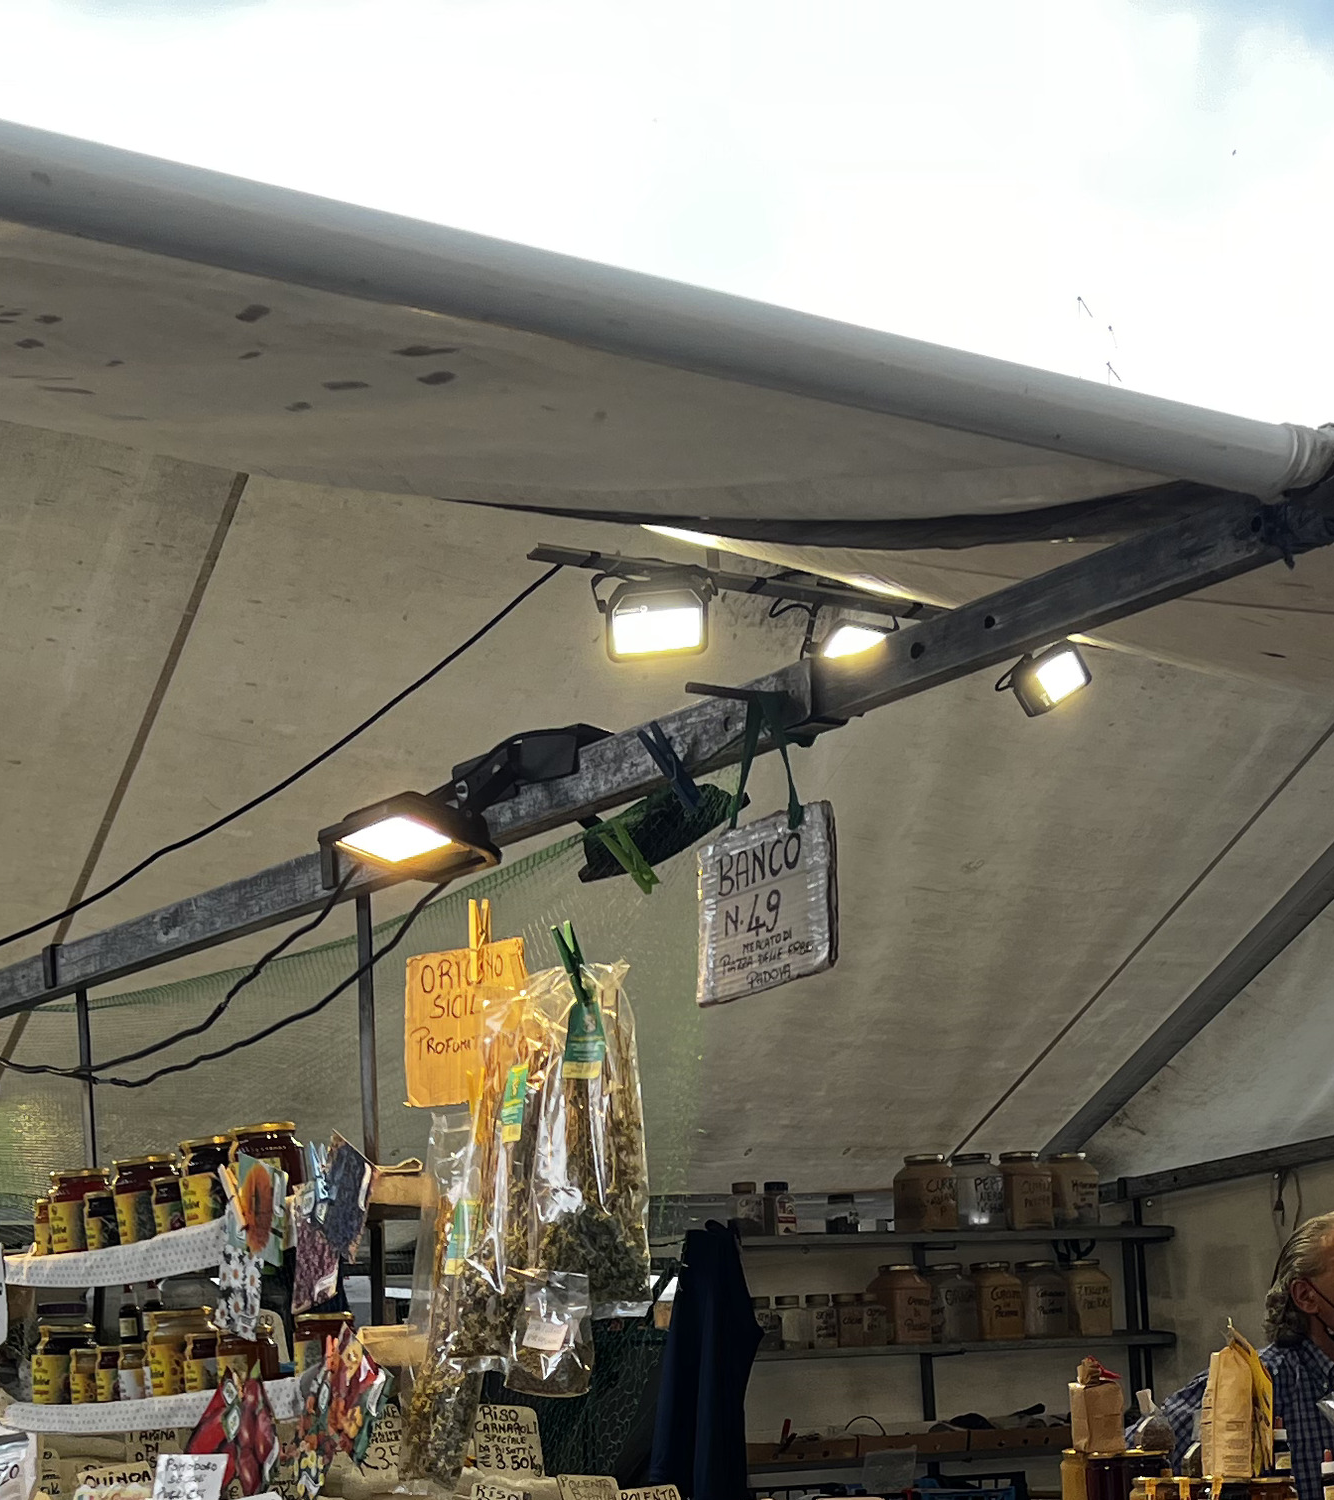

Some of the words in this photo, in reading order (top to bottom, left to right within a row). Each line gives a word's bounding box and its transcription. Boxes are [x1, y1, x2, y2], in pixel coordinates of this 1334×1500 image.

[717, 833, 801, 896] BANCO
[746, 964, 792, 987] PADOVA
[479, 1406, 519, 1422] RISO
[475, 1421, 537, 1435] CARNAROLI
[85, 1471, 152, 1488] QUINOA
